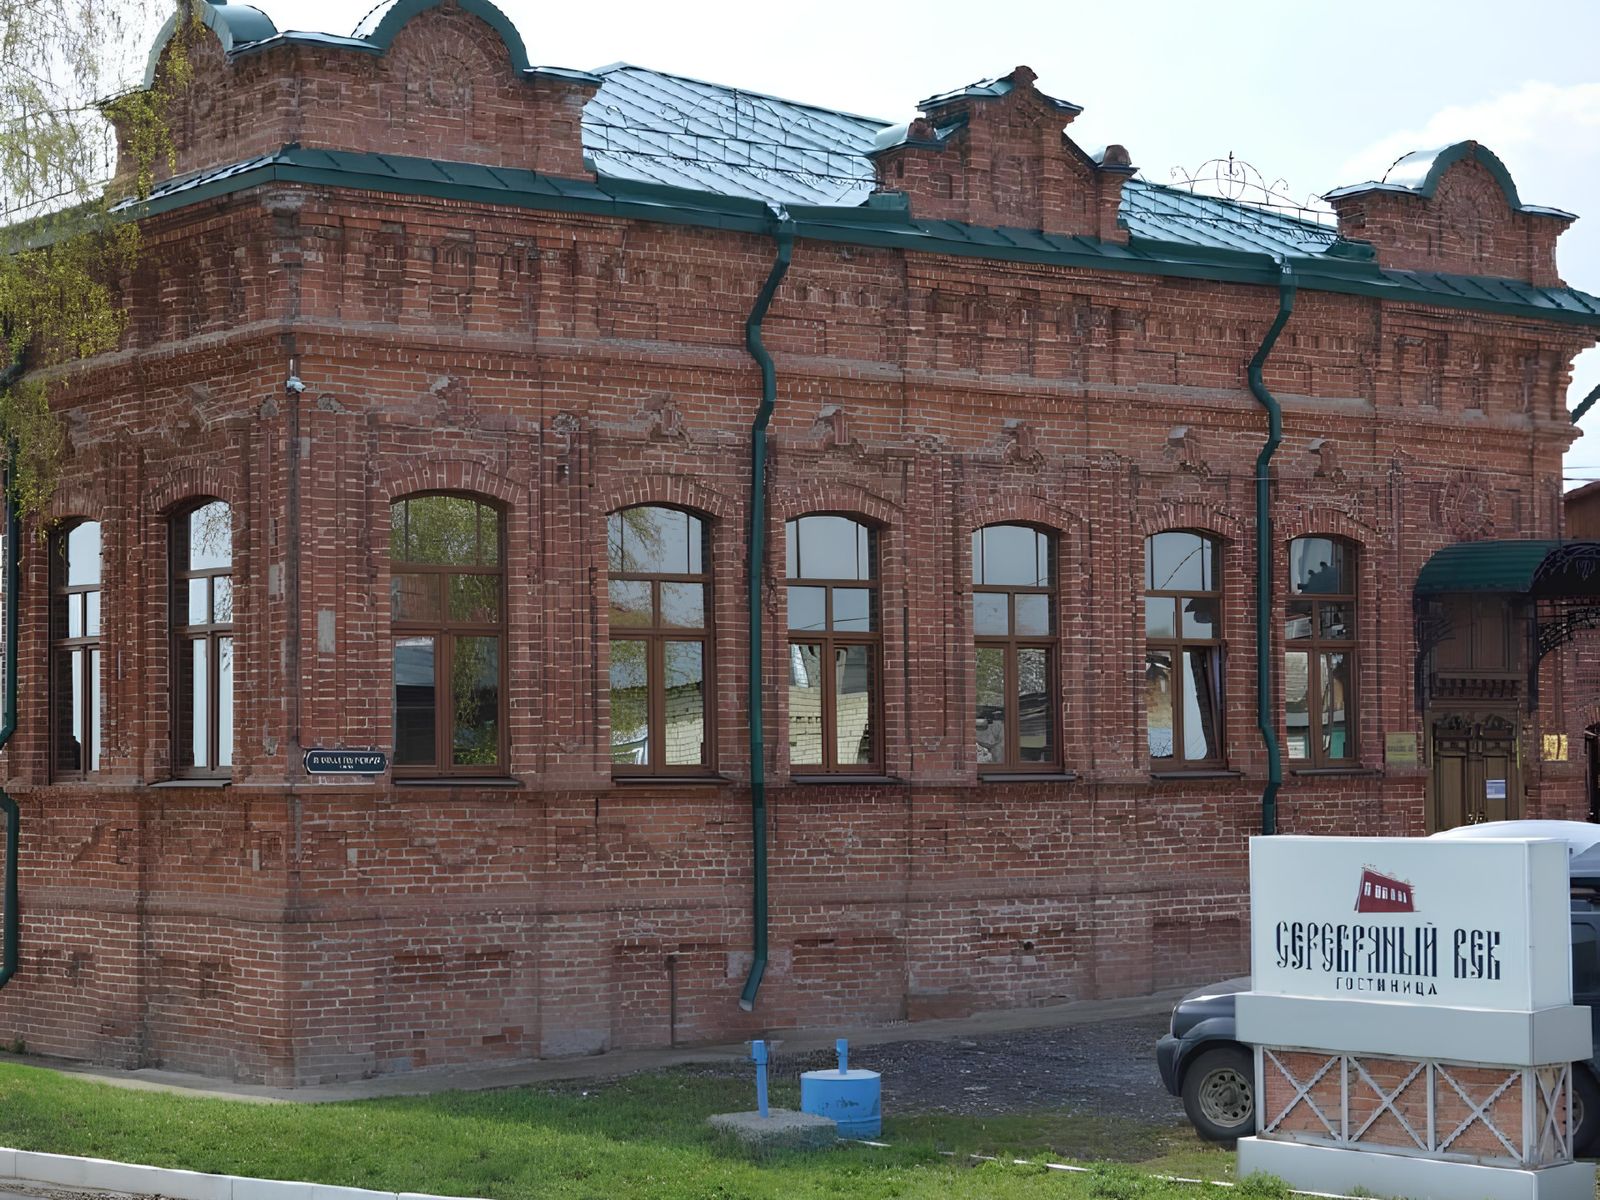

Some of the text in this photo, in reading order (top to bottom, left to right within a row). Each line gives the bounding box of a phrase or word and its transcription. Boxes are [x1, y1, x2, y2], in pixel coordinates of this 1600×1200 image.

[1276, 921, 1501, 980] СЕРЕБРЯНЫЙ ВЕК
[1336, 977, 1438, 996] ГОСТИНИЦА
